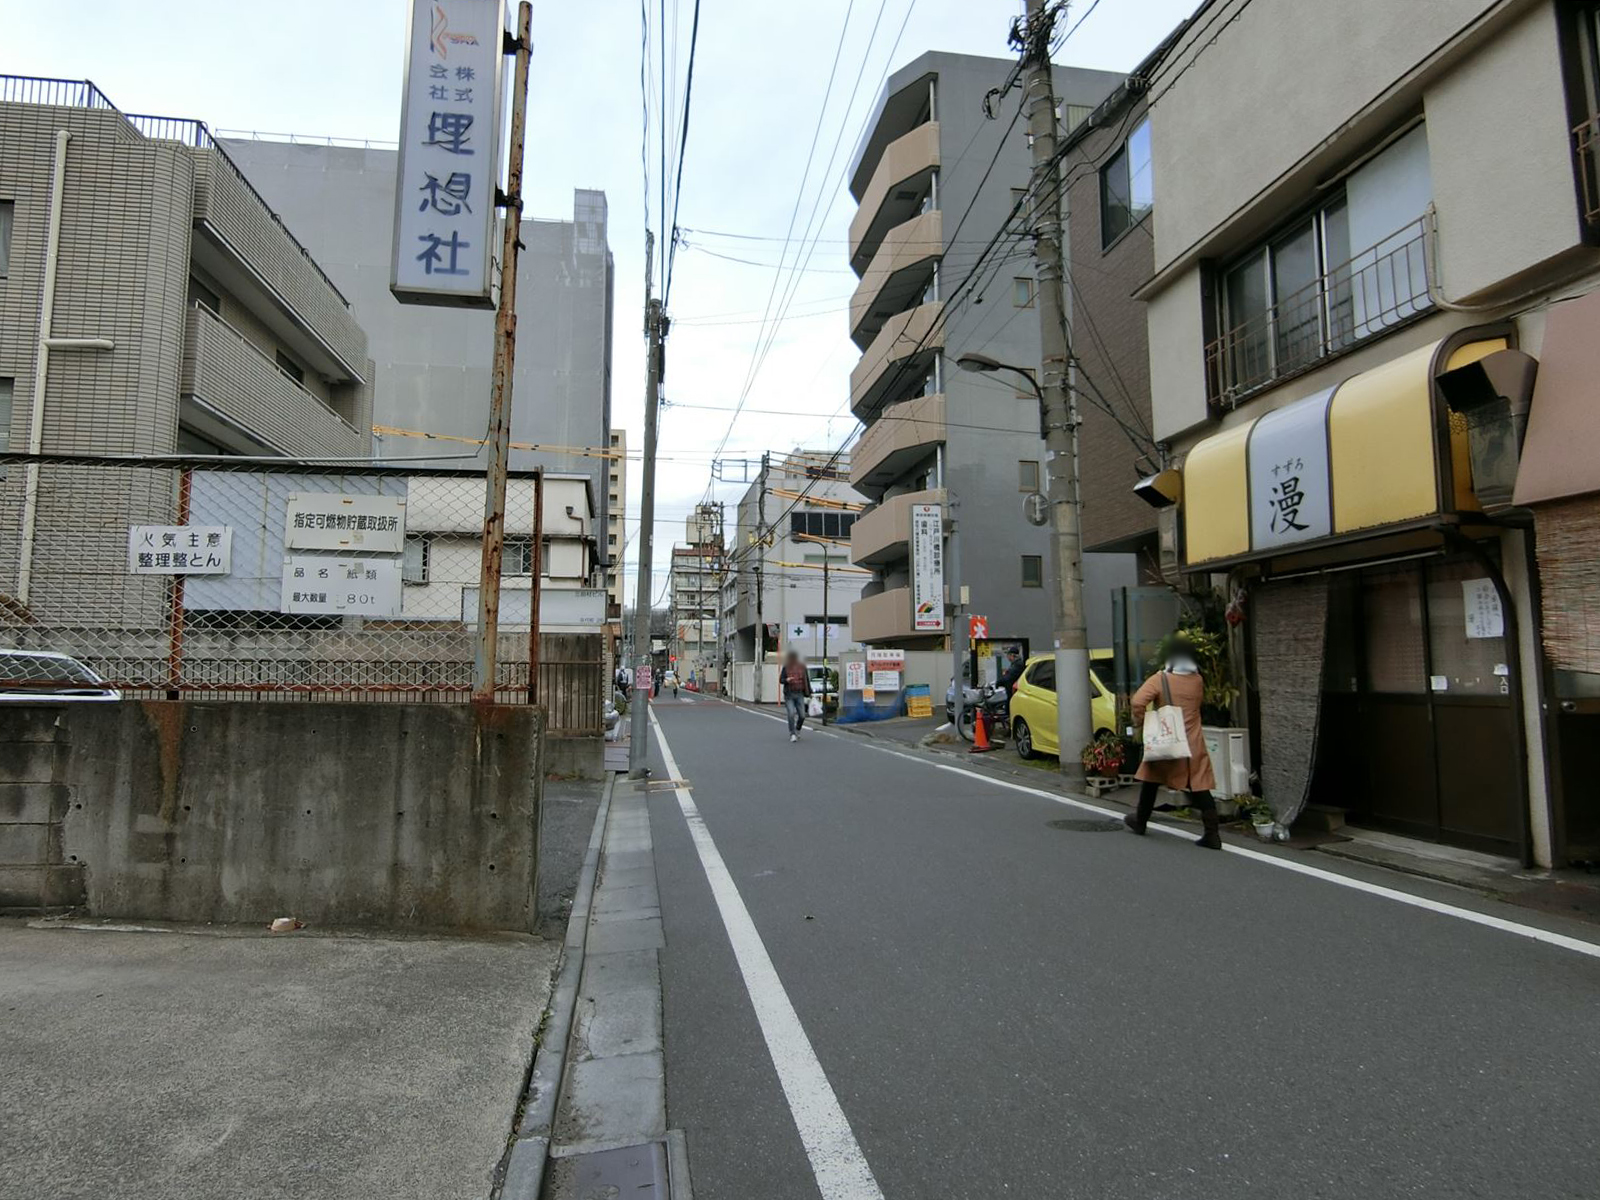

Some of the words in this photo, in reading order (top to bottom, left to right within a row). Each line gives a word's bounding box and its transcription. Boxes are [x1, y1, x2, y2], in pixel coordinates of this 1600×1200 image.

[416, 111, 475, 276] 理想社
[1268, 475, 1310, 535] 漫
[293, 512, 399, 532] 指定可燃物貯蔵取扱所
[138, 552, 221, 568] 整理整とん
[294, 567, 329, 578] 品名
[293, 592, 327, 603] 最大数量
